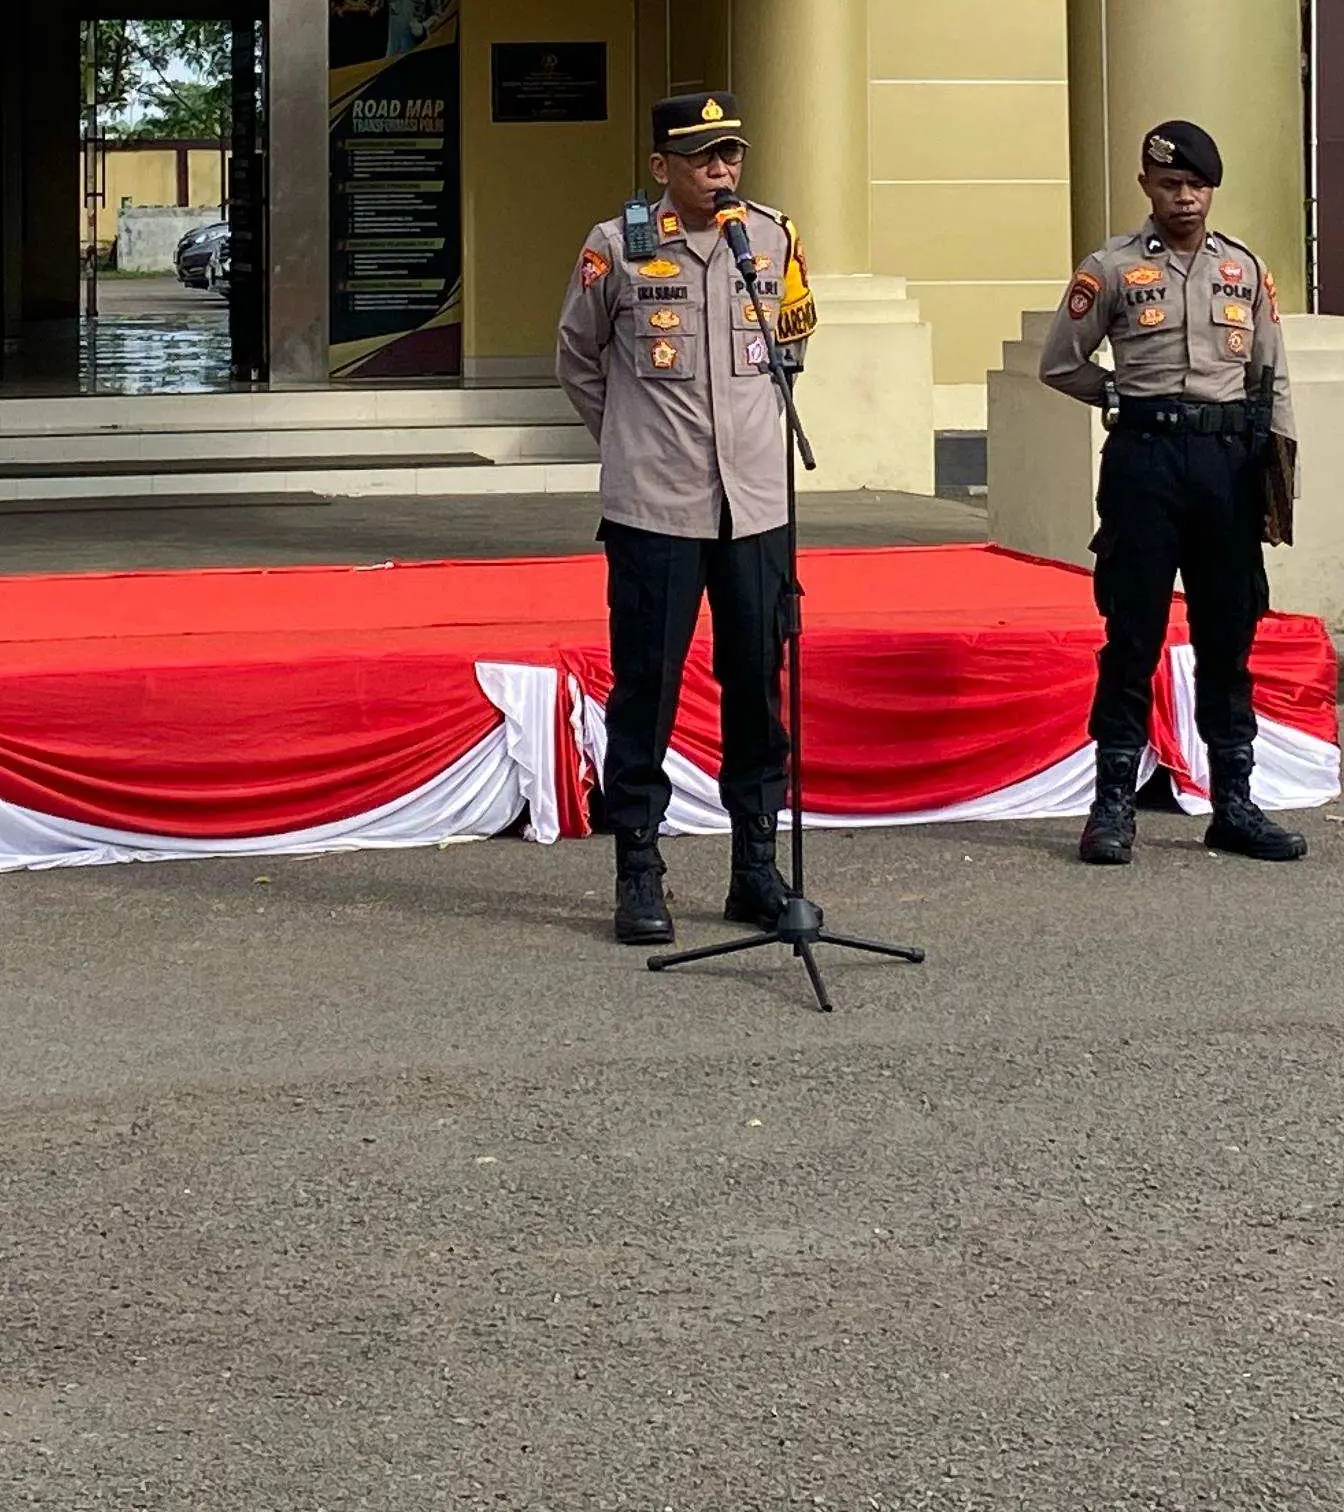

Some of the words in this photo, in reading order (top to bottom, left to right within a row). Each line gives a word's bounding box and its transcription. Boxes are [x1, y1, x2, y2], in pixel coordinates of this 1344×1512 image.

[353, 99, 401, 118] ROAD
[406, 99, 445, 118] MAP
[735, 280, 778, 295] PLRI
[1126, 287, 1167, 306] LEXY
